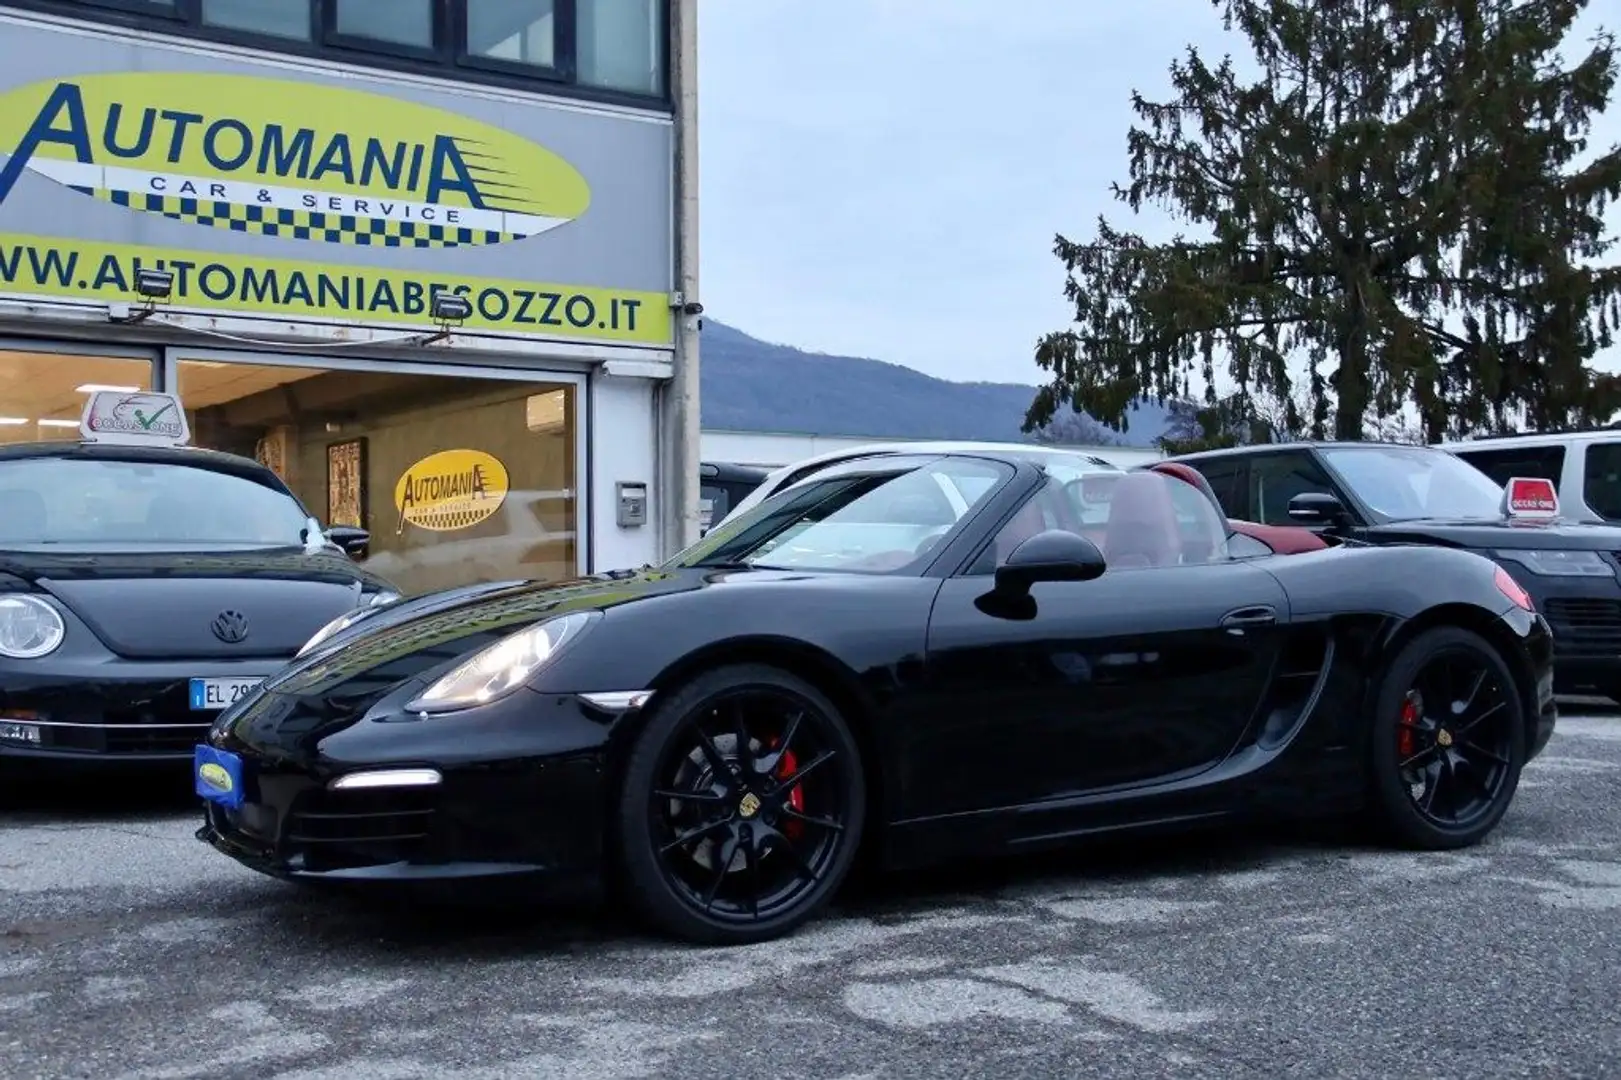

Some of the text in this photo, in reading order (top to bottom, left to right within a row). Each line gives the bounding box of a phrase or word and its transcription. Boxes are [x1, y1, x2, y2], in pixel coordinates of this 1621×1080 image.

[0, 82, 486, 209] AUTOMANIA
[150, 176, 460, 223] CAR & SERVICE
[91, 417, 179, 433] OCCASONE
[396, 464, 485, 533] AUTOMANIA
[206, 684, 225, 703] EL
[231, 683, 259, 703] 29
